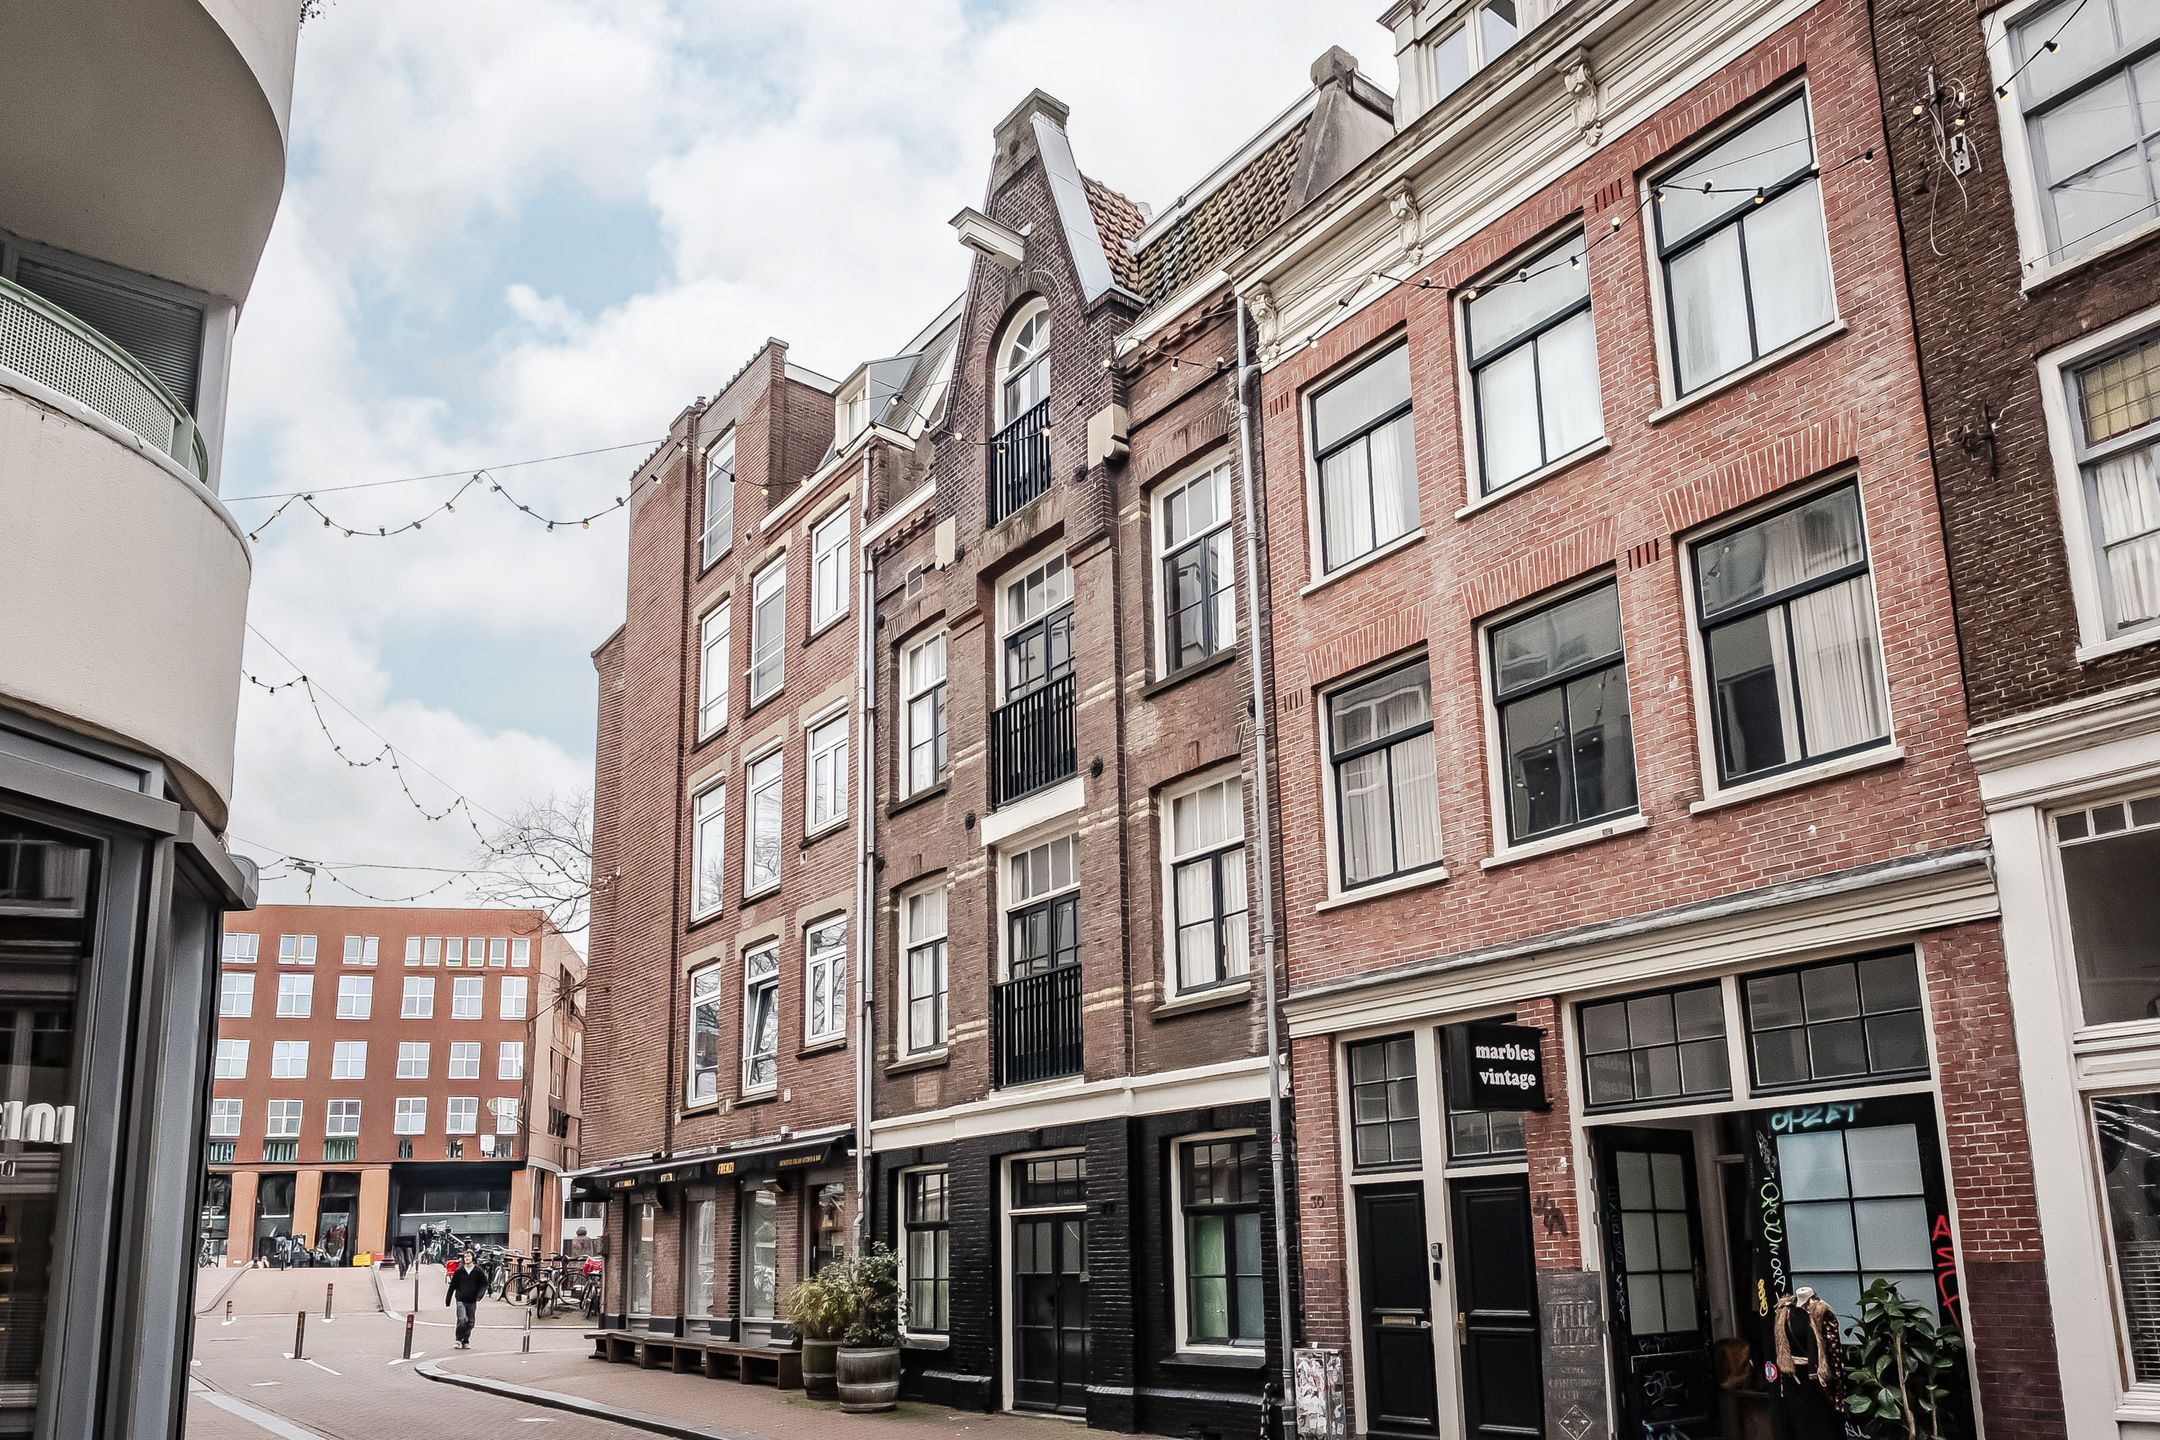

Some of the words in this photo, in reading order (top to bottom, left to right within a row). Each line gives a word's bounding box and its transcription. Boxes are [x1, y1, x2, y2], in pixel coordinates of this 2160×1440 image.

[1475, 1043, 1536, 1062] marbles
[1479, 1067, 1537, 1090] vintage
[1310, 1195, 1325, 1209] 30
